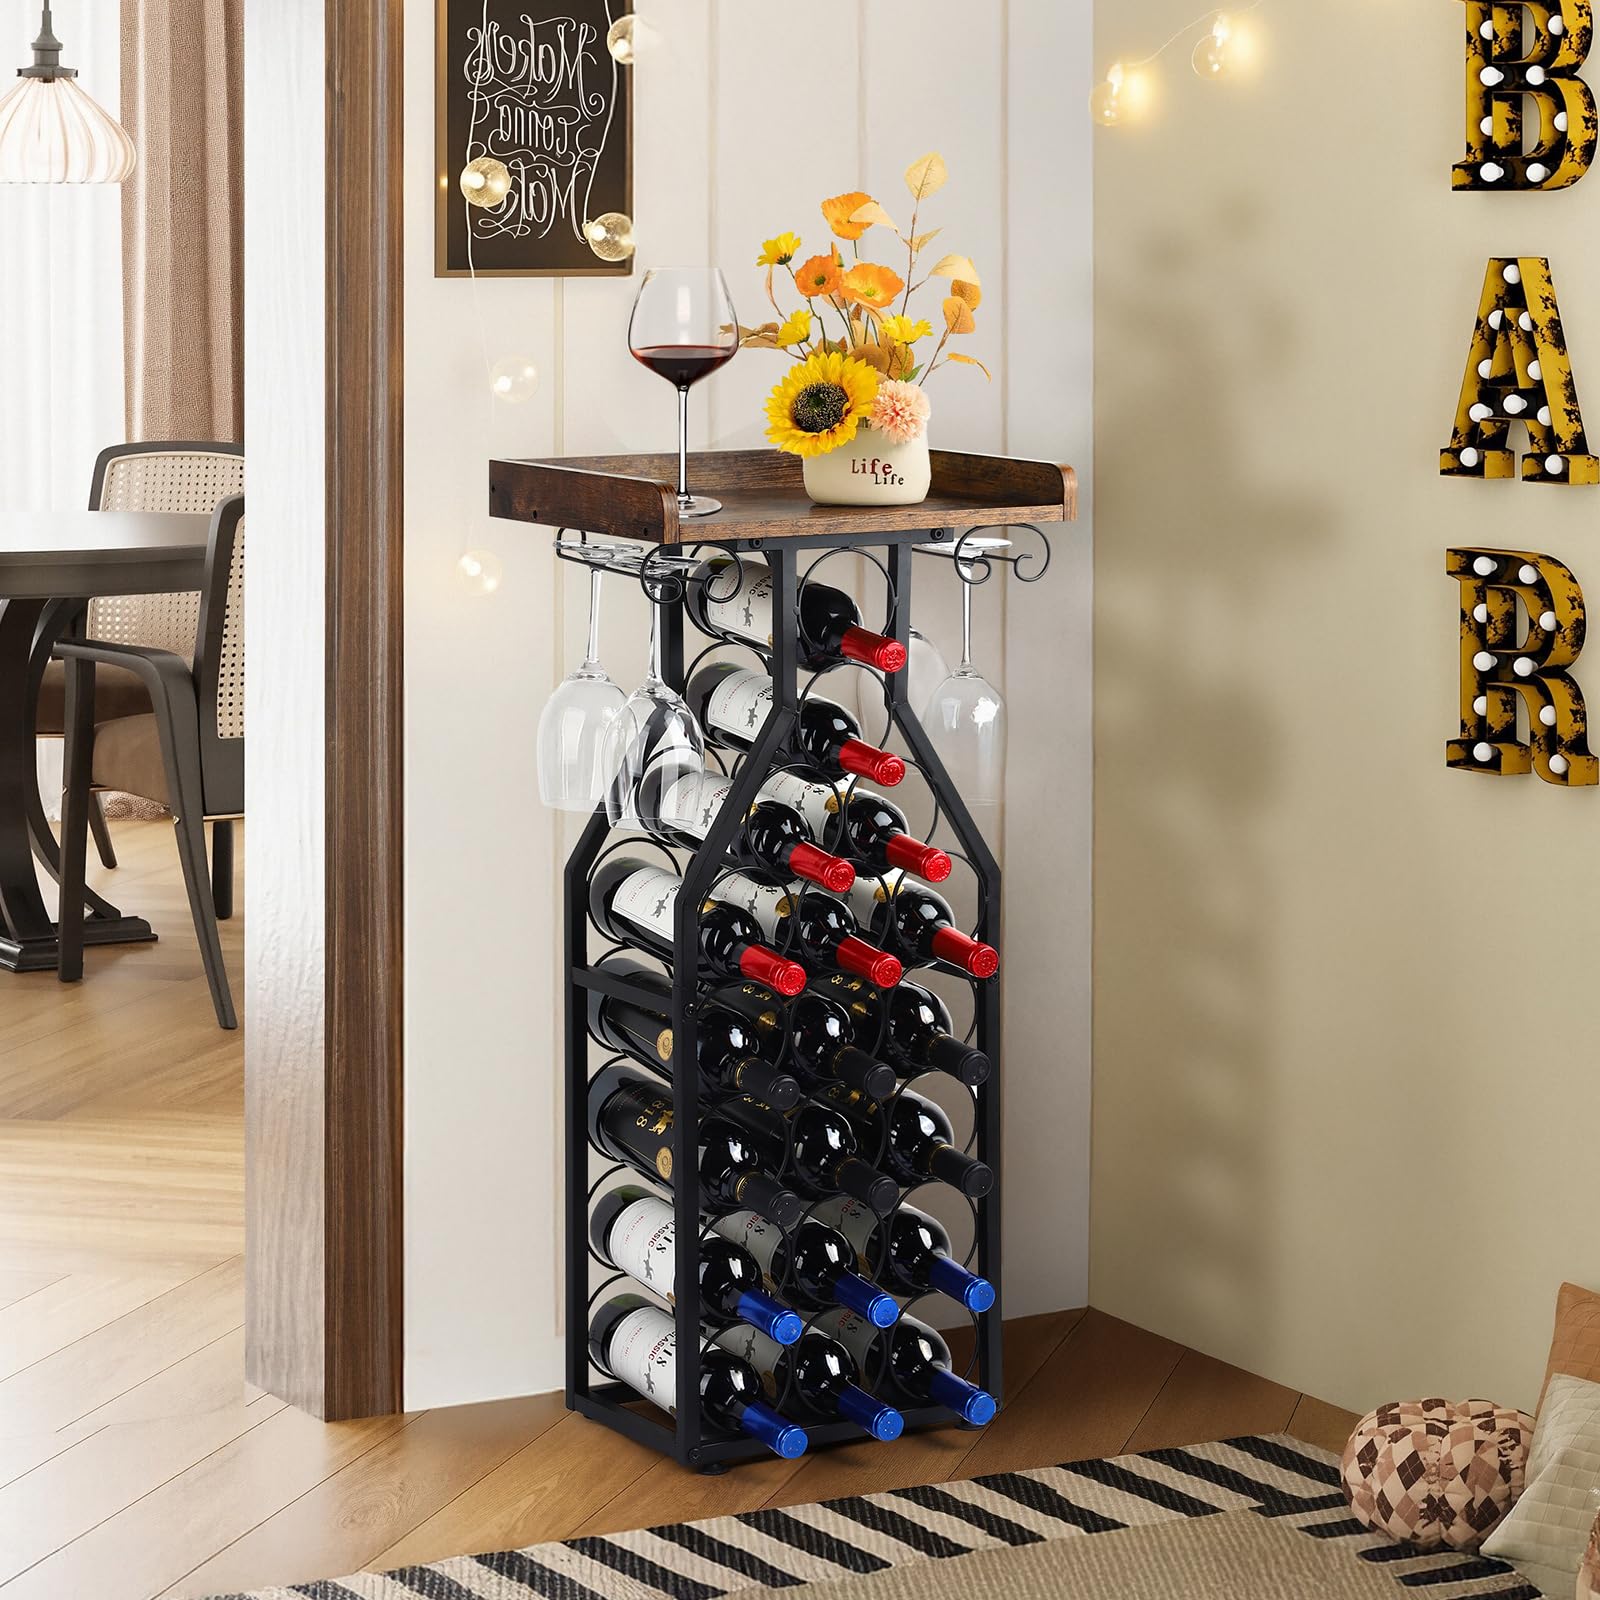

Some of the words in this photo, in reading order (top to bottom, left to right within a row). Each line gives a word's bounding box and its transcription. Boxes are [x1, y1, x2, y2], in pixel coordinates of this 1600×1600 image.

[851, 458, 893, 475] Life
[874, 472, 904, 485] Life
[636, 1100, 665, 1128] 818
